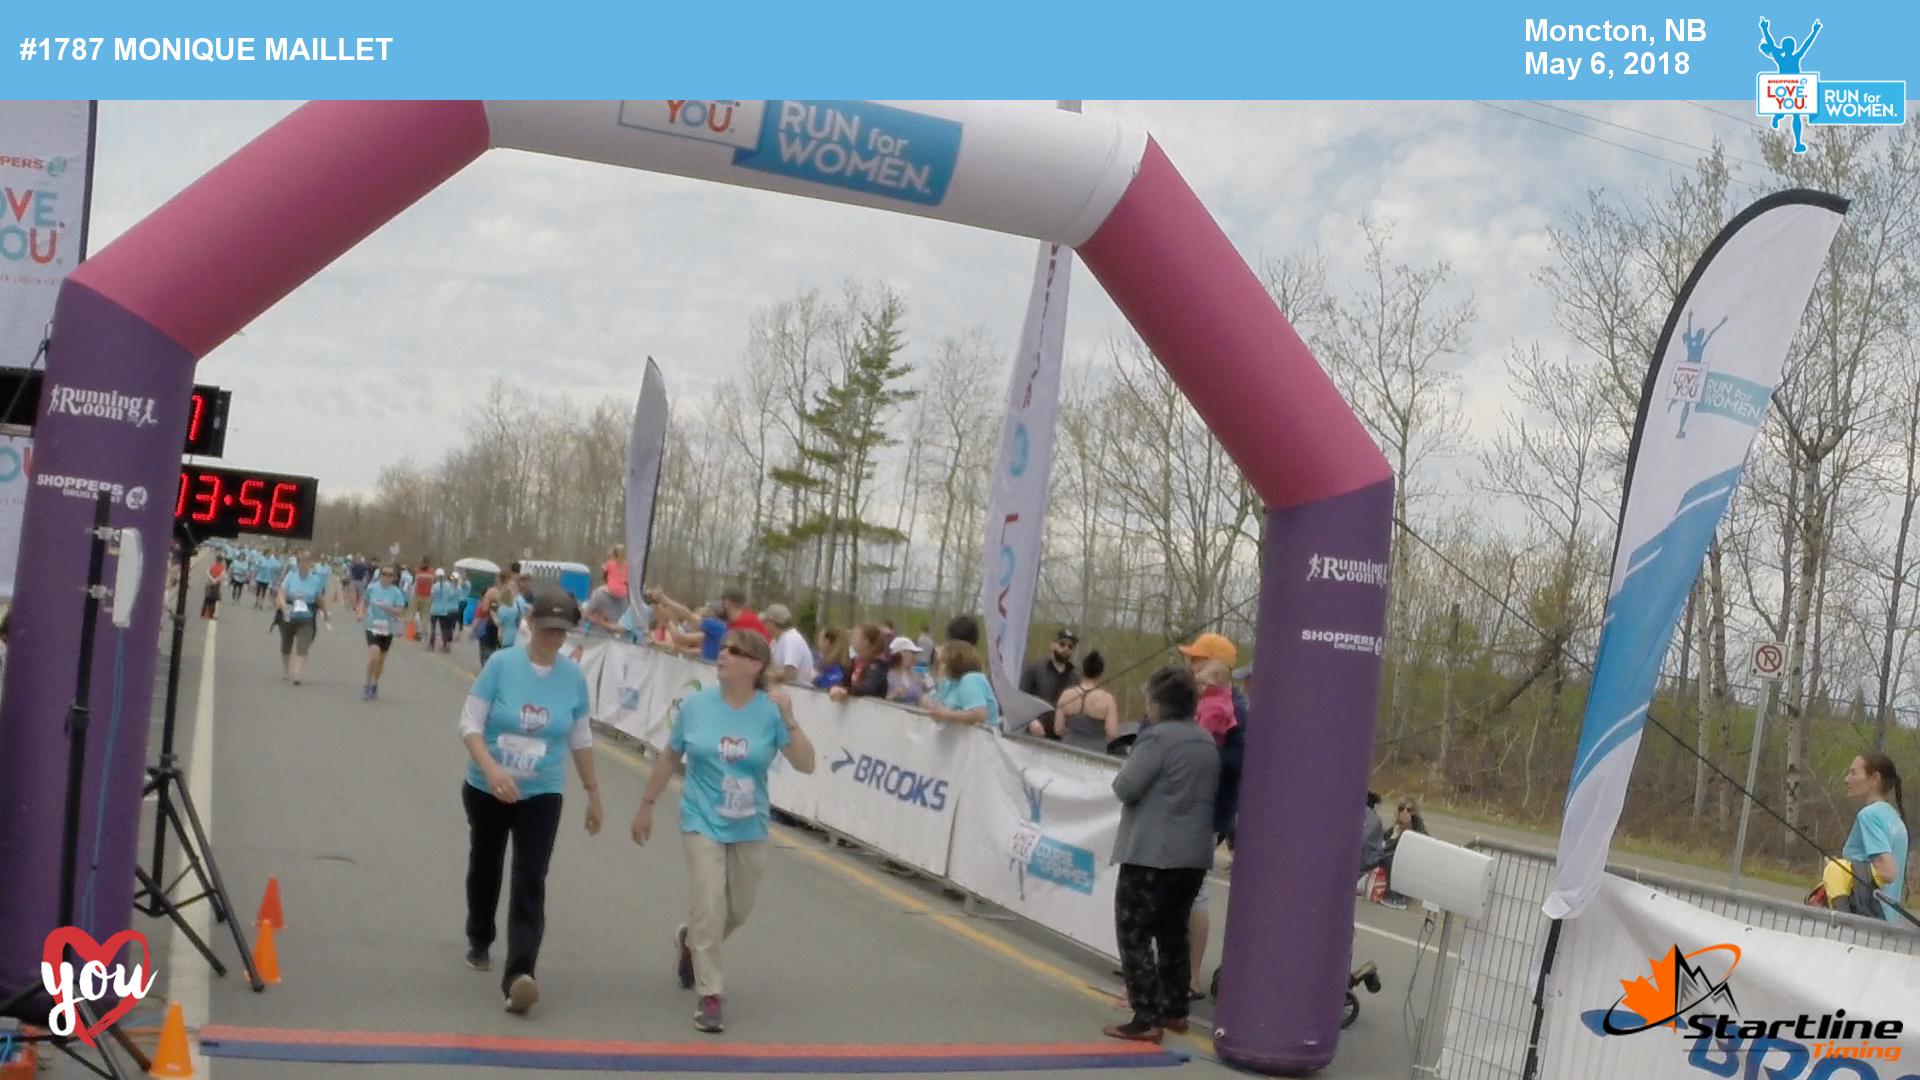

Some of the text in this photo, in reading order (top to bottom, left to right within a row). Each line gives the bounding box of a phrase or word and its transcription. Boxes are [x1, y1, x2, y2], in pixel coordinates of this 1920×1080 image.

[779, 101, 910, 153] RUN for
[779, 131, 931, 195] WOMEN.
[59, 386, 142, 418] Running
[1706, 379, 1733, 394] RUN
[36, 474, 124, 496] SHOPPERS
[1302, 630, 1375, 646] SHOPPERS
[854, 755, 949, 812] BROOKS
